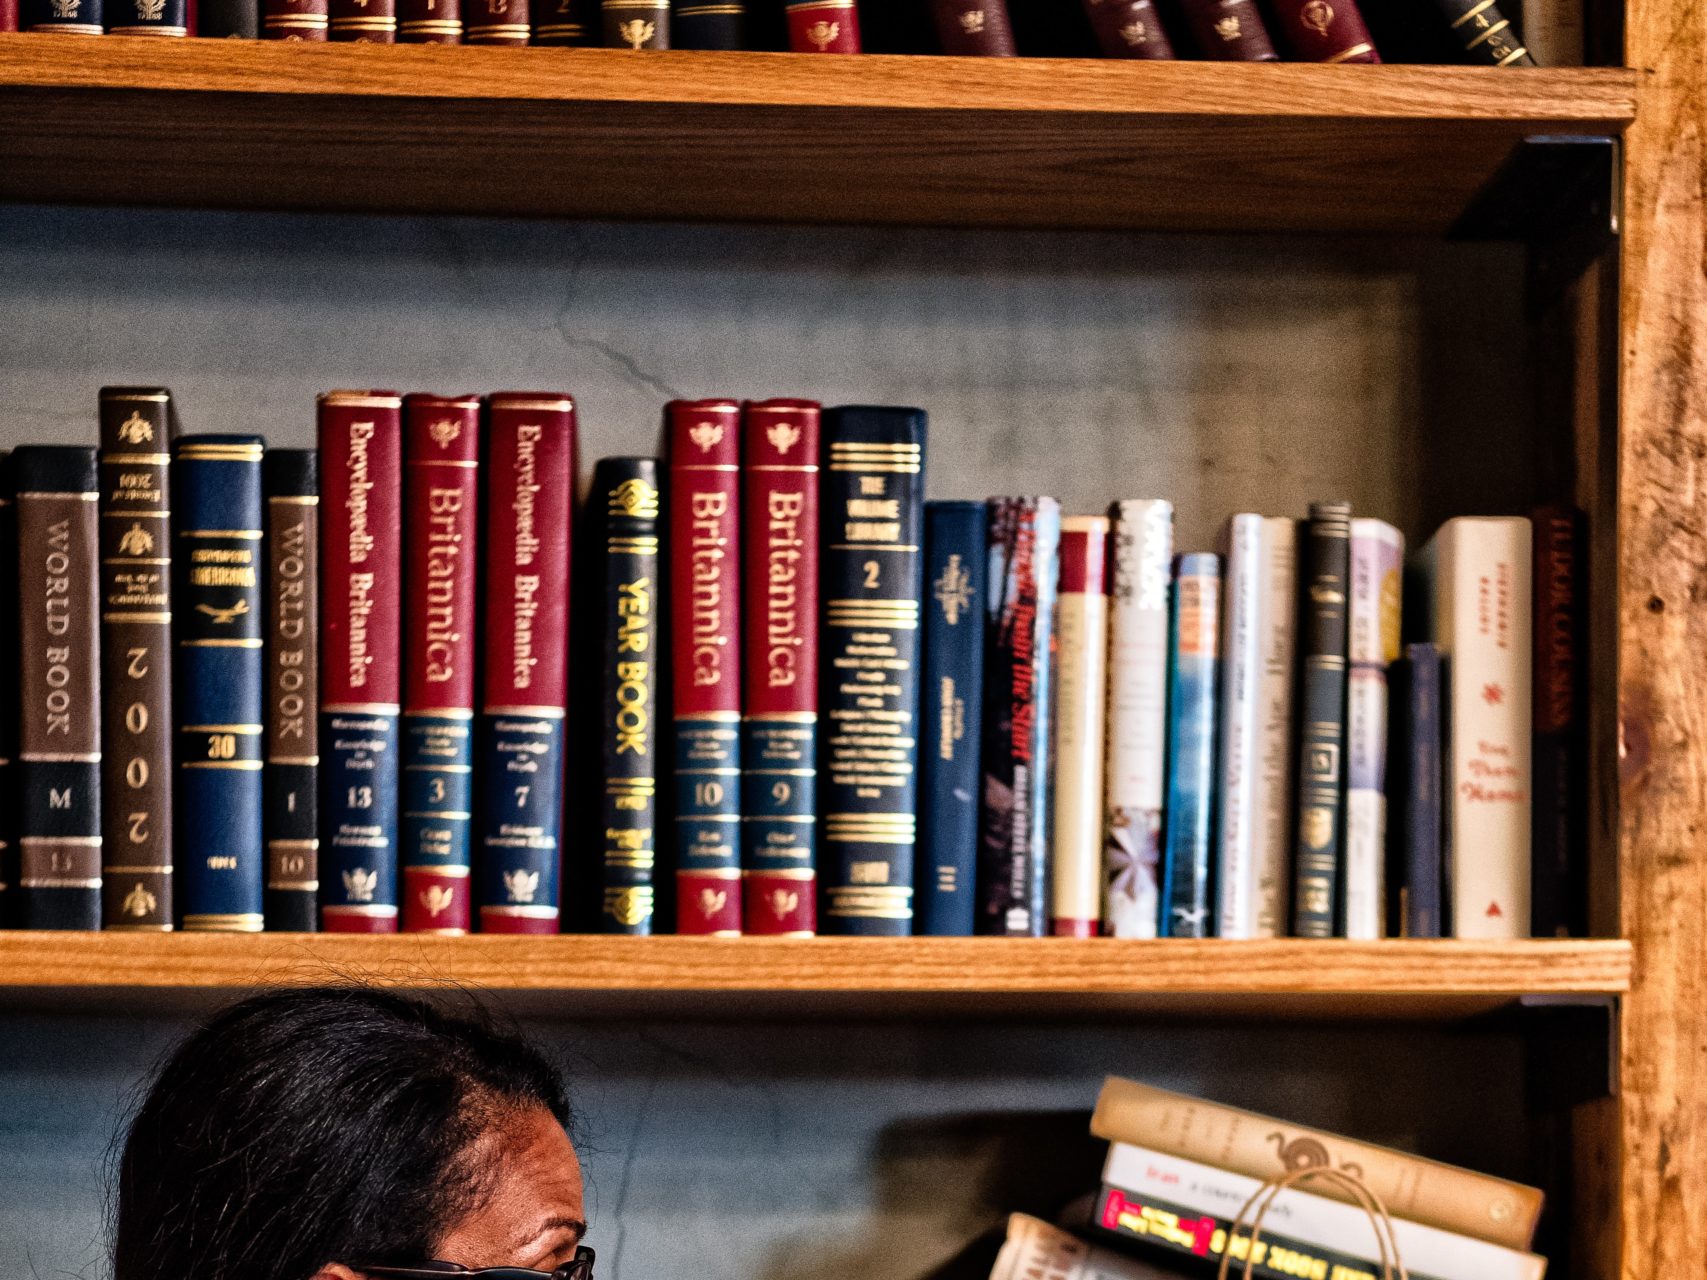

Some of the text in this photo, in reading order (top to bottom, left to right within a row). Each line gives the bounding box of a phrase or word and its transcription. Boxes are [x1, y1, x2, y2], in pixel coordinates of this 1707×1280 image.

[427, 488, 462, 682] Britannica
[692, 491, 727, 687] Britannica
[768, 490, 803, 687] Britannica
[863, 561, 880, 589] 2
[46, 519, 70, 736] WORLD BOOK
[279, 520, 304, 739] WORLD BOOK
[349, 572, 374, 688] Britannica
[514, 575, 540, 689] Britannica
[616, 577, 649, 755] YEAR BOOK
[208, 735, 237, 759] 30
[49, 788, 72, 809] M
[347, 785, 373, 809] 13
[428, 778, 445, 803] 3
[515, 786, 530, 808] 7
[694, 781, 724, 806] 10
[772, 781, 791, 806] 9
